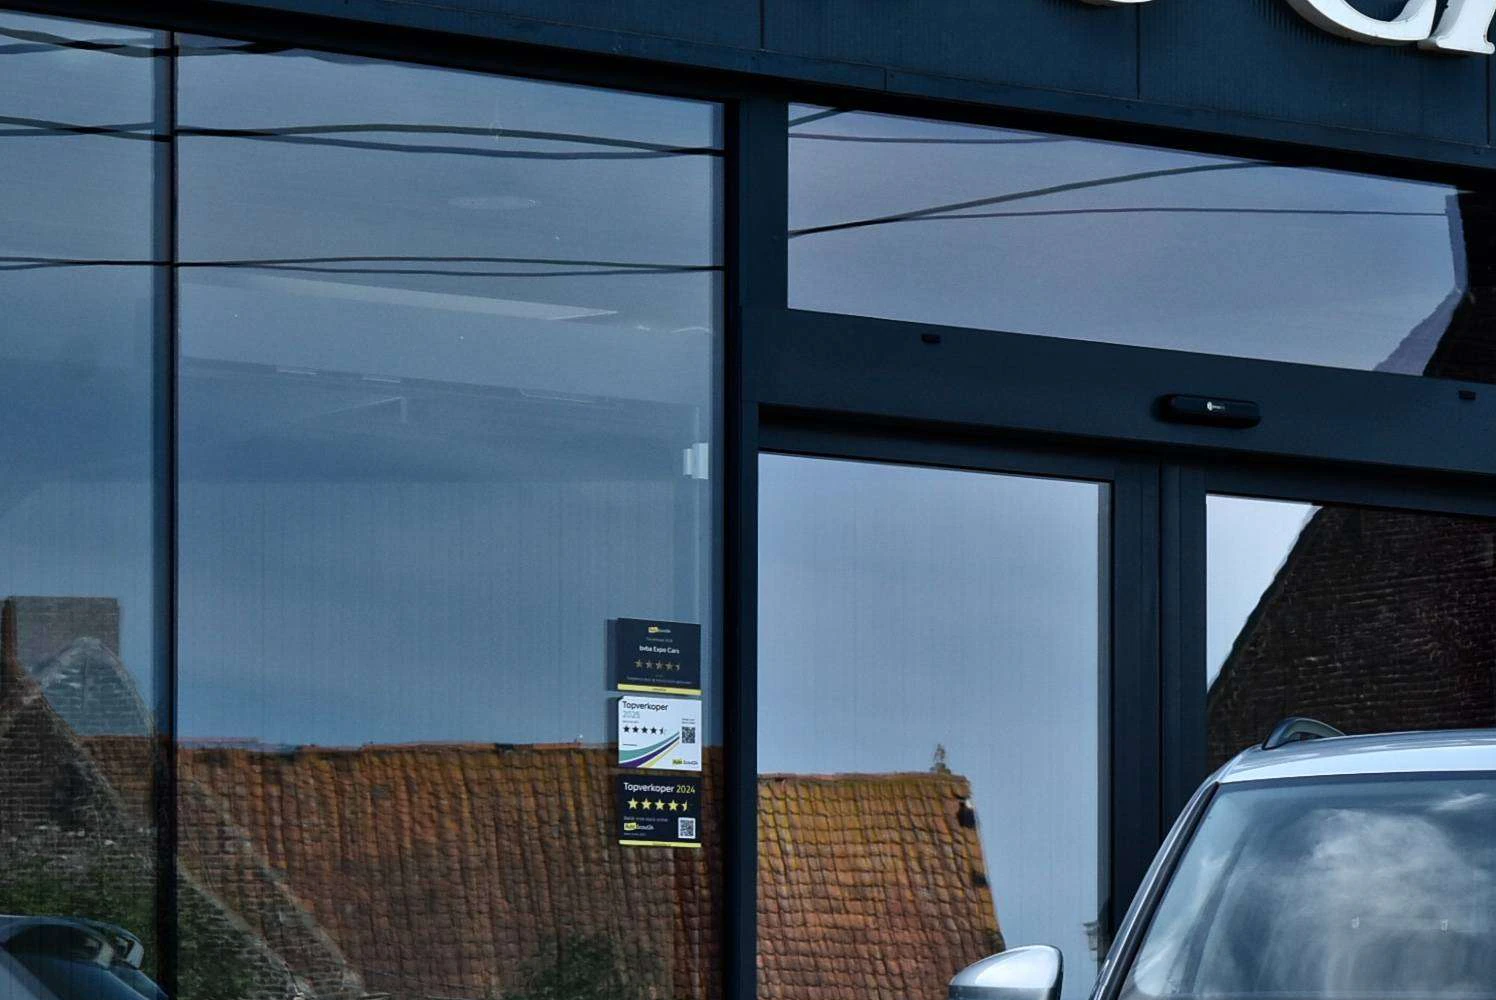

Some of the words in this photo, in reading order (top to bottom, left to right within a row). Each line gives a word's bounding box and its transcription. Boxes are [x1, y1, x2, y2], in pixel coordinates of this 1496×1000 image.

[623, 700, 669, 712] Topverkoper
[623, 782, 675, 795] Topverkoper
[676, 785, 696, 794] 2024
